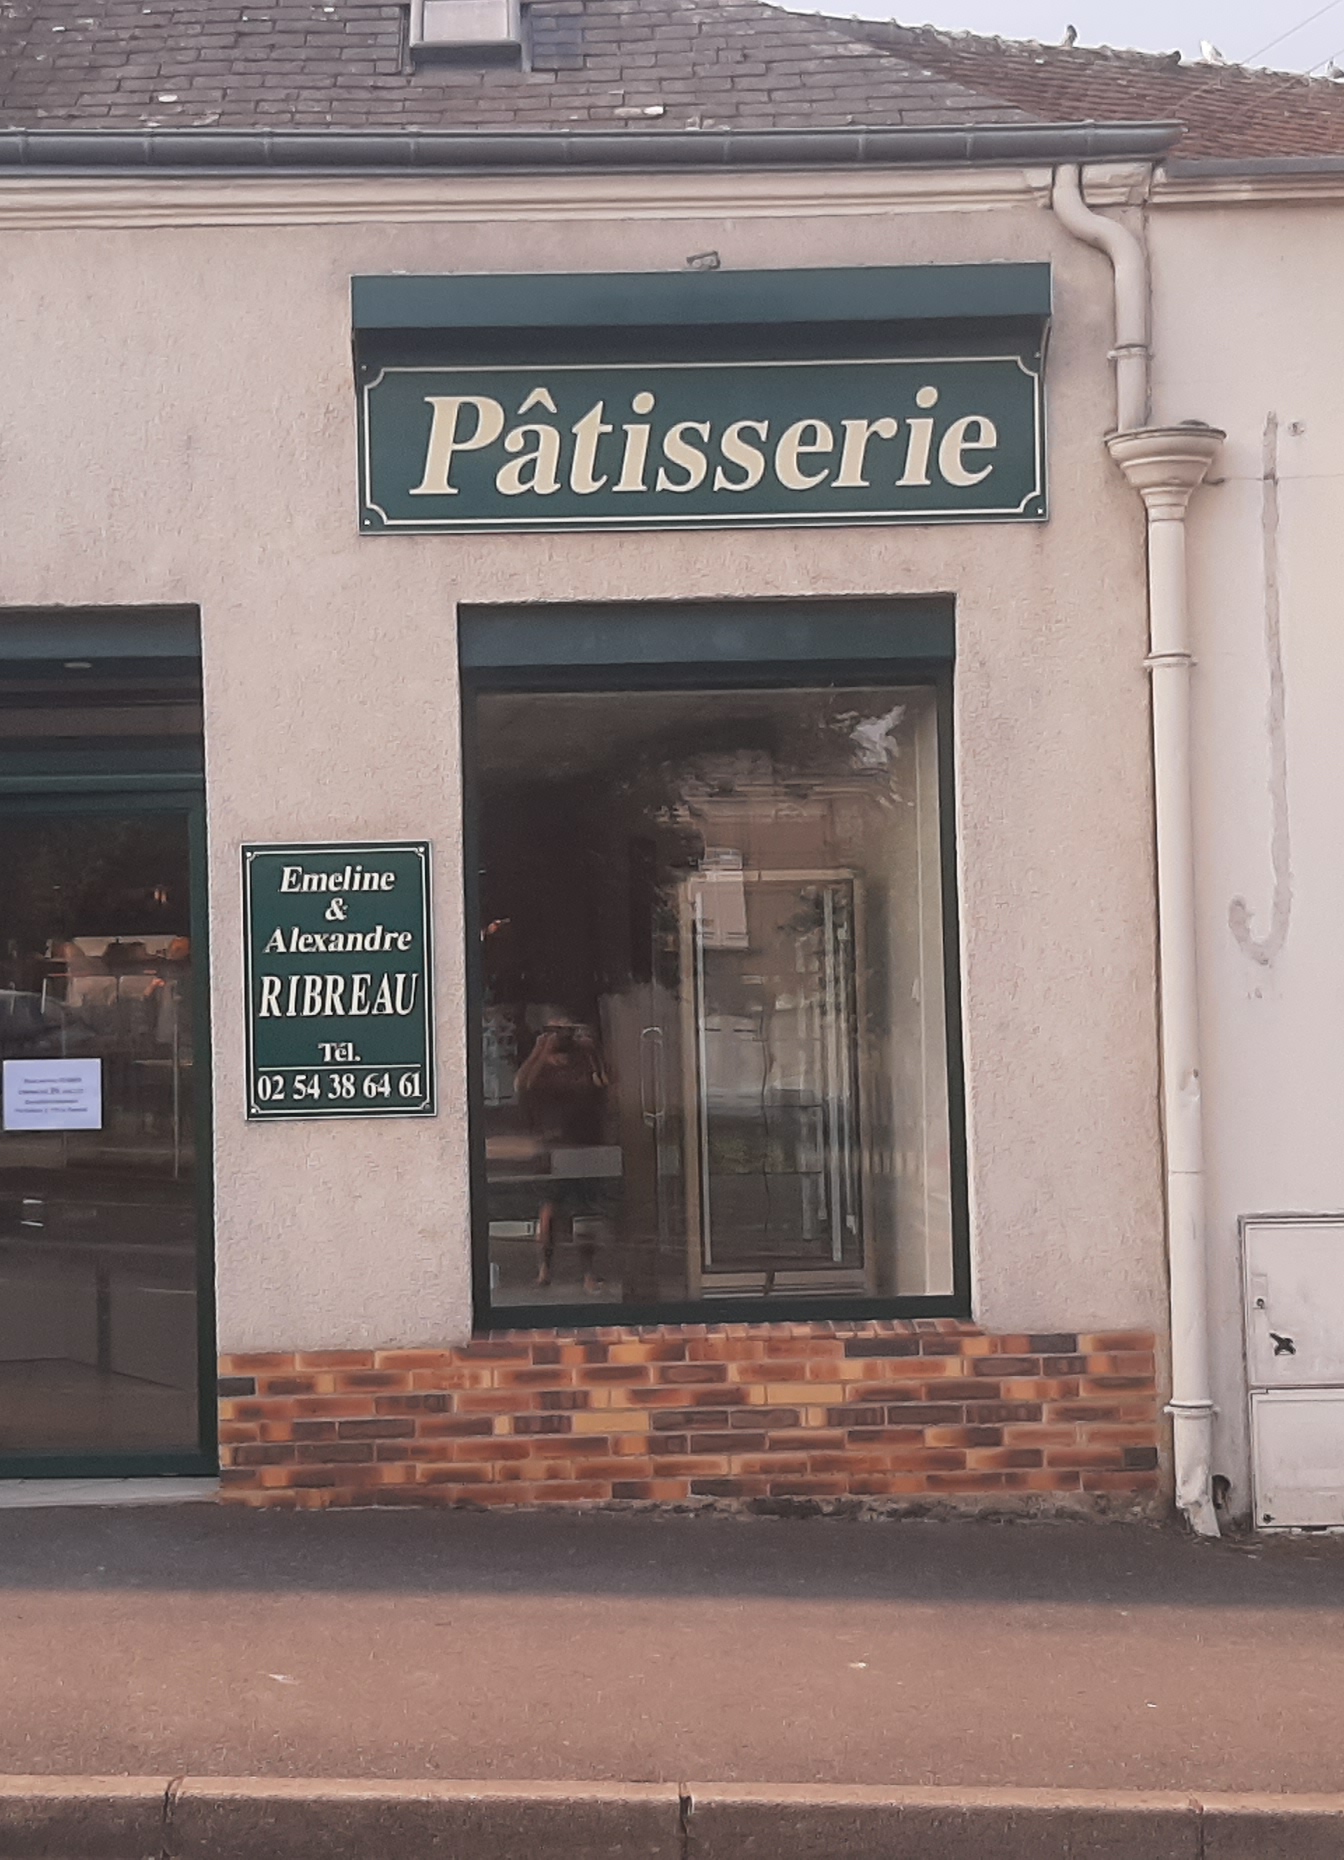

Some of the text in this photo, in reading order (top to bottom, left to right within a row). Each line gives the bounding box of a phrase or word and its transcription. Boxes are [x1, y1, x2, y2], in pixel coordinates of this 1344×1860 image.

[409, 386, 997, 495] Pâtisserie
[279, 865, 396, 893] Emeline
[324, 898, 348, 921] &
[264, 925, 413, 953] Alexandre
[258, 972, 419, 1017] RIBREAU
[318, 1042, 362, 1062] Tél.
[257, 1071, 422, 1100] 02 54 38 64 61
